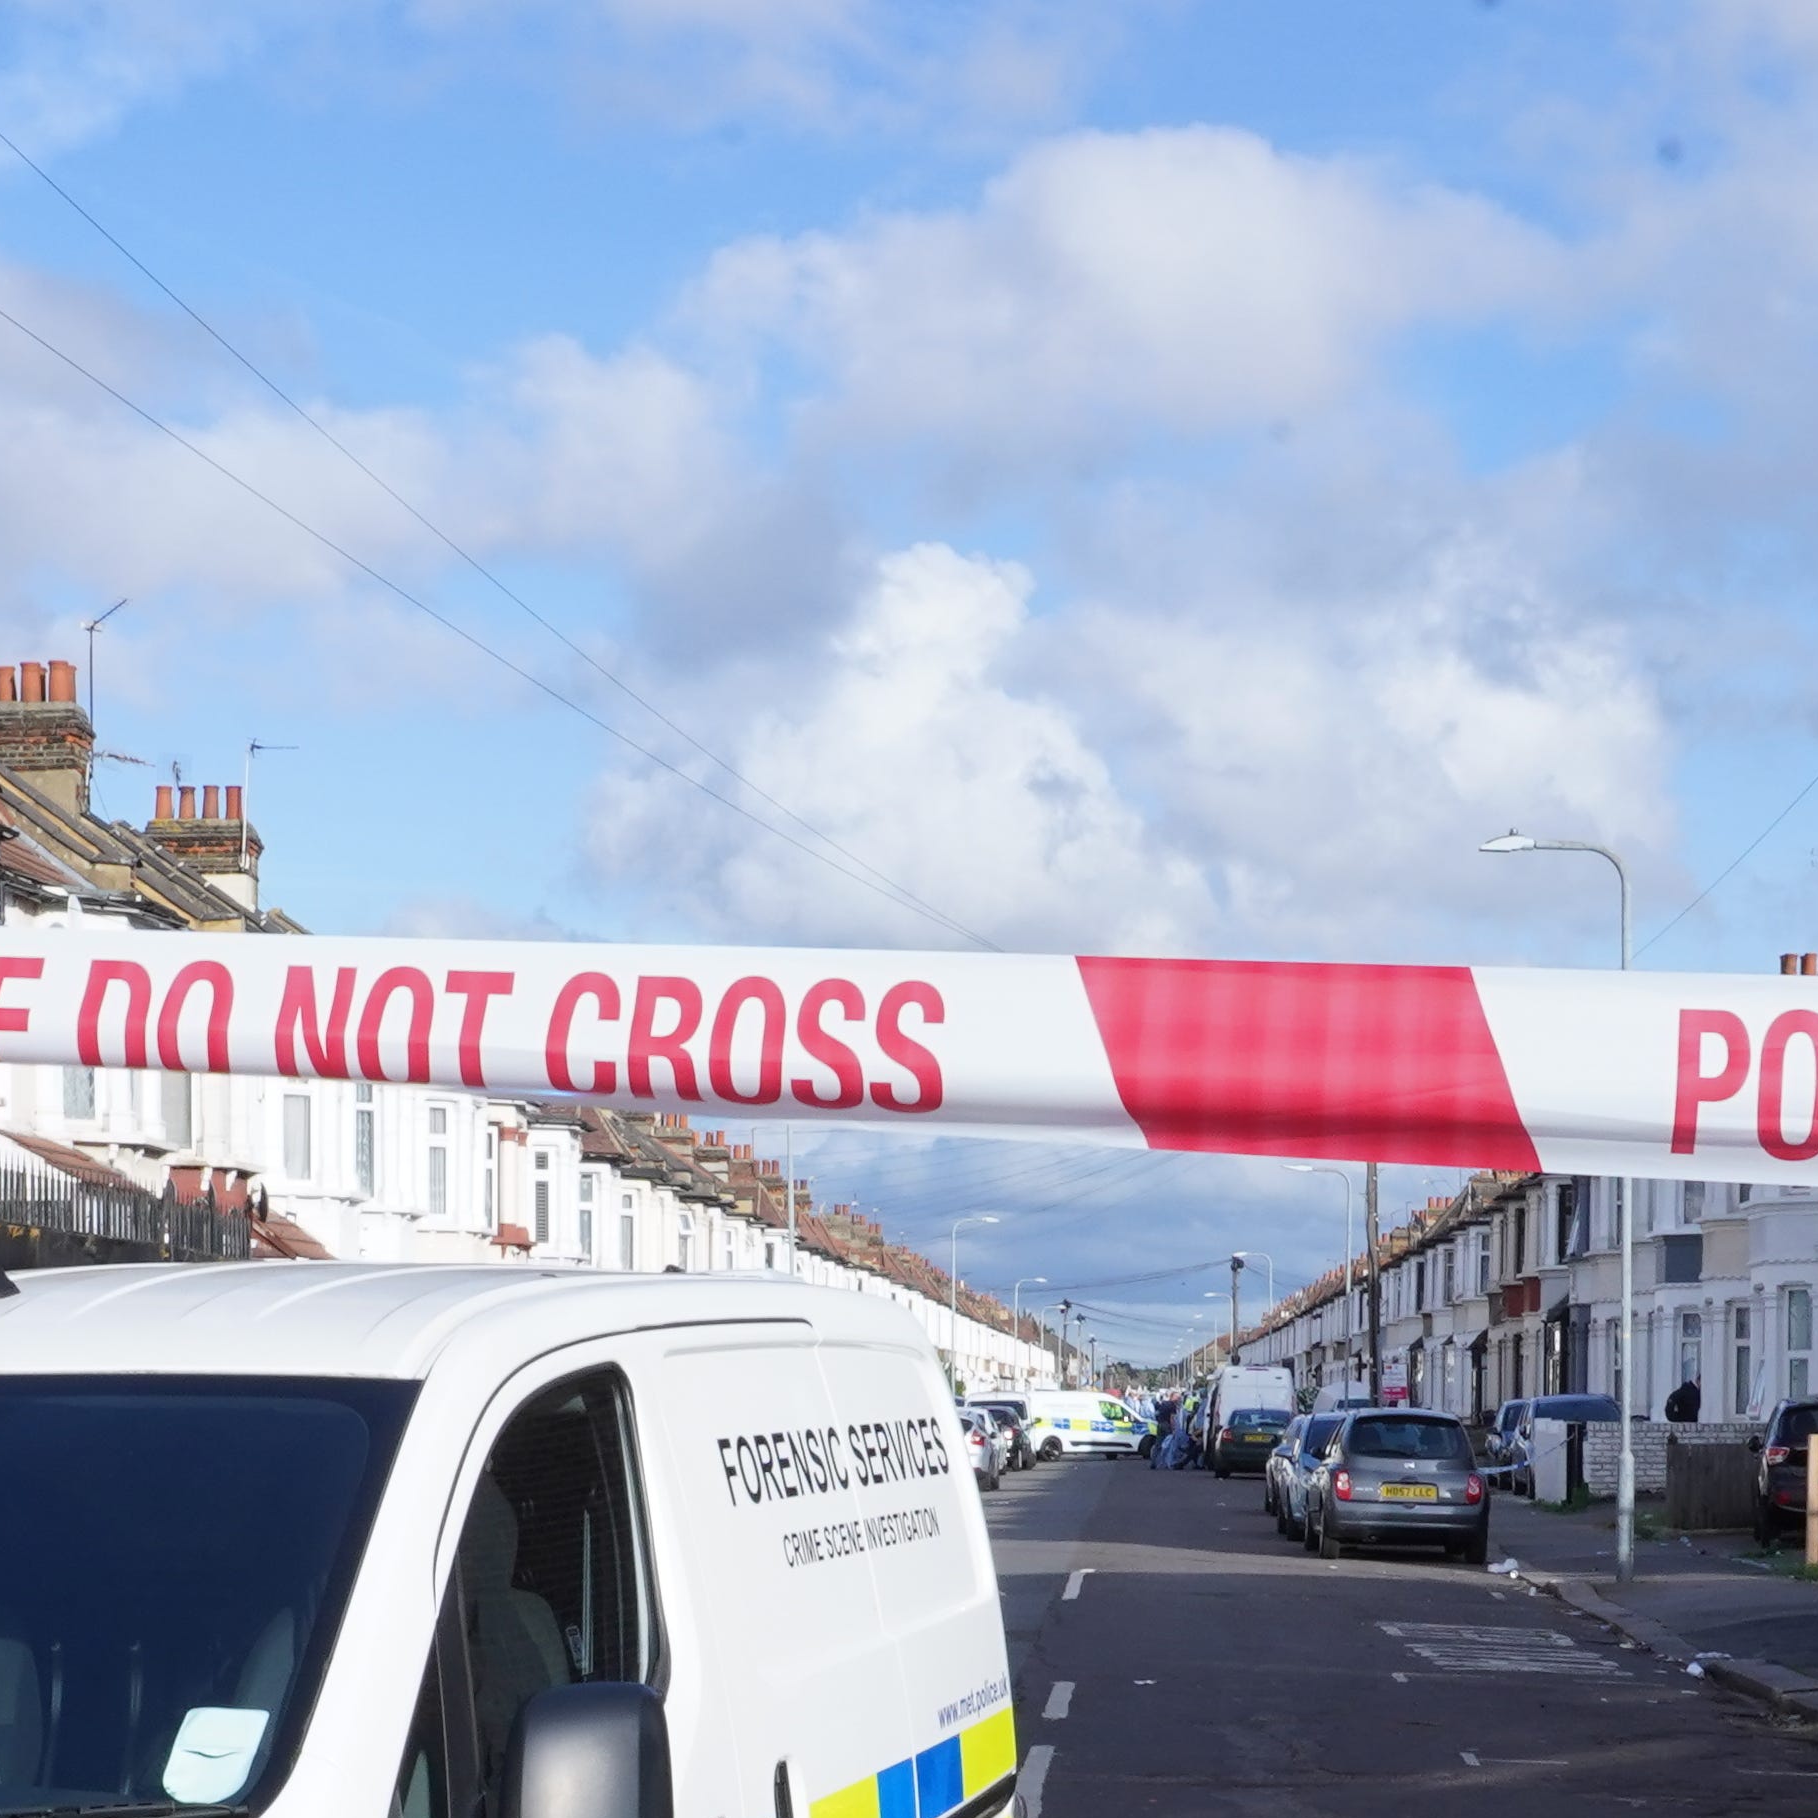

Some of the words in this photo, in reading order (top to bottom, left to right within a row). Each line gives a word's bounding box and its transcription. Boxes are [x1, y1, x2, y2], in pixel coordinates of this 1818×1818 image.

[76, 957, 235, 1074] DO
[274, 964, 516, 1089] NOT
[545, 970, 946, 1115] CROSS
[716, 1426, 850, 1507] FORENSIC
[848, 1416, 950, 1487] SERVICES
[783, 1528, 825, 1568] CRIME
[823, 1520, 865, 1560] SCENE
[863, 1506, 941, 1551] INVESTIGATION
[937, 1672, 1009, 1730] www.met.police.uk
